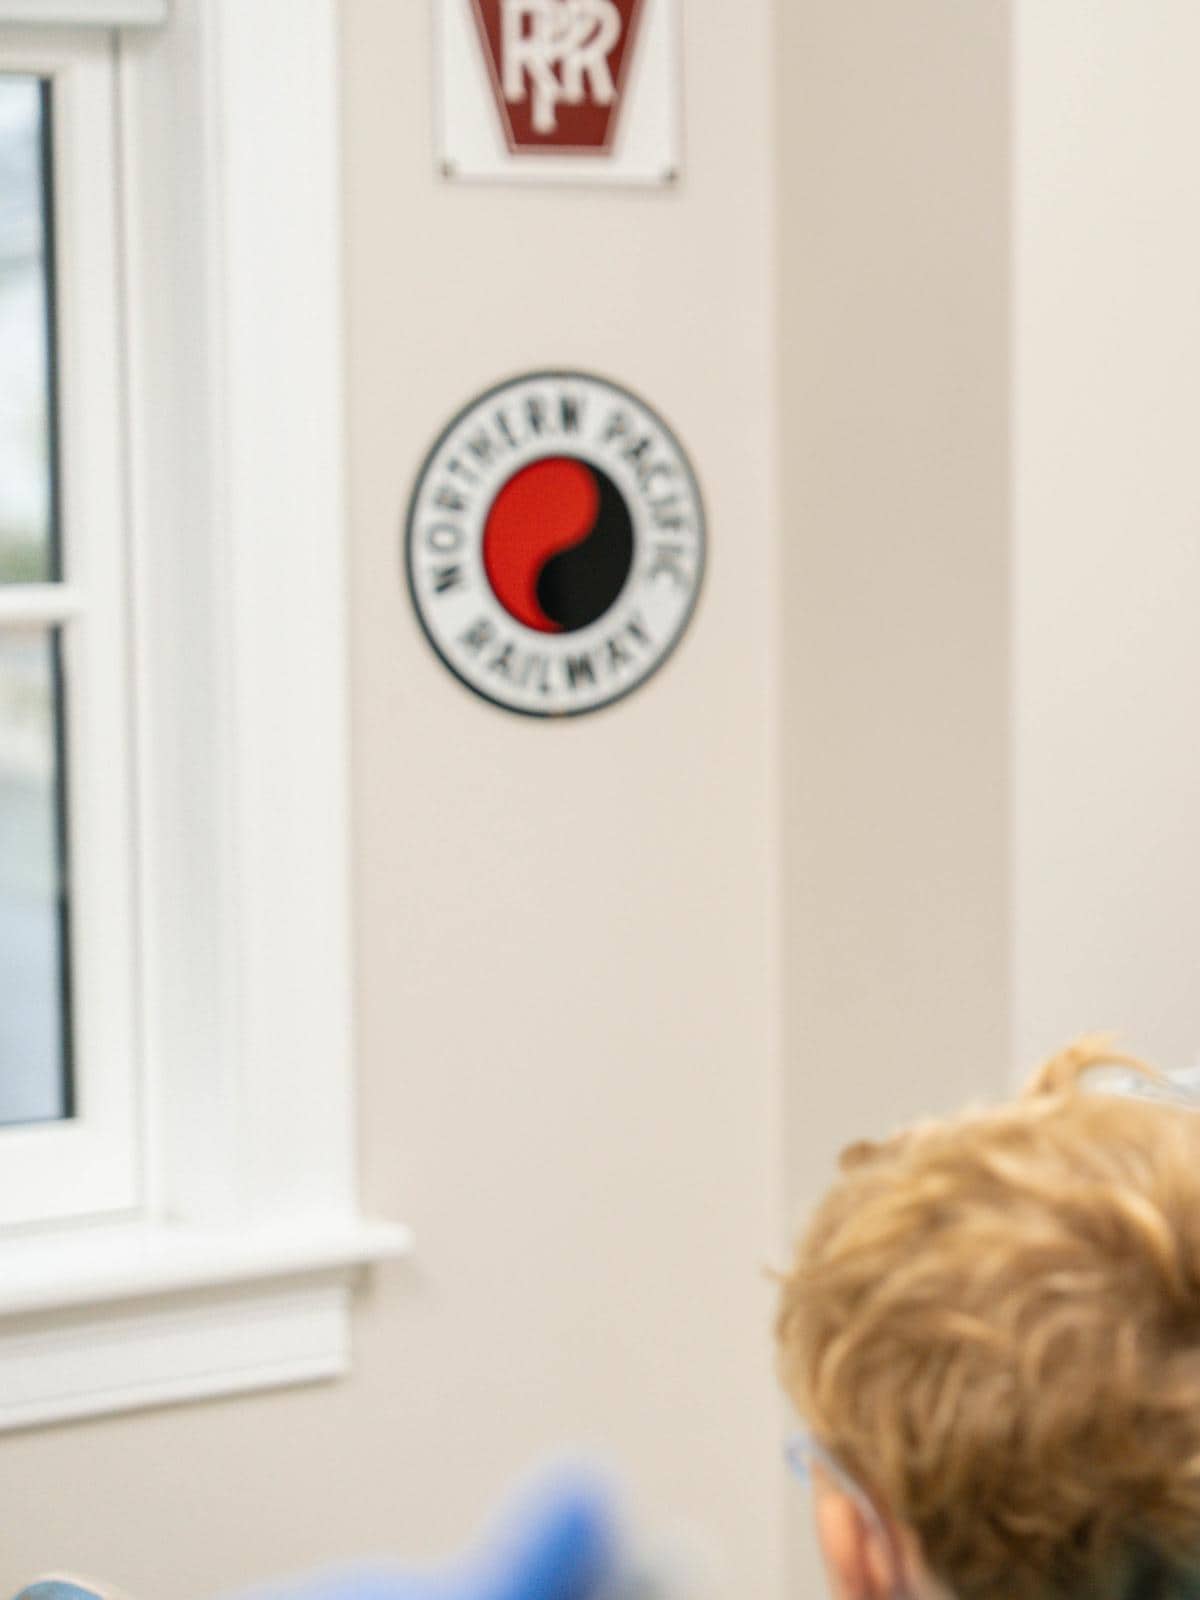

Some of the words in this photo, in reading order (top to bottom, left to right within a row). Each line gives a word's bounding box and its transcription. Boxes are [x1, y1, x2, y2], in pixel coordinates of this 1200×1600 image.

[427, 396, 586, 595] NORTHERN
[603, 409, 689, 593] PACIFIC
[458, 612, 650, 693] RAILWAY
